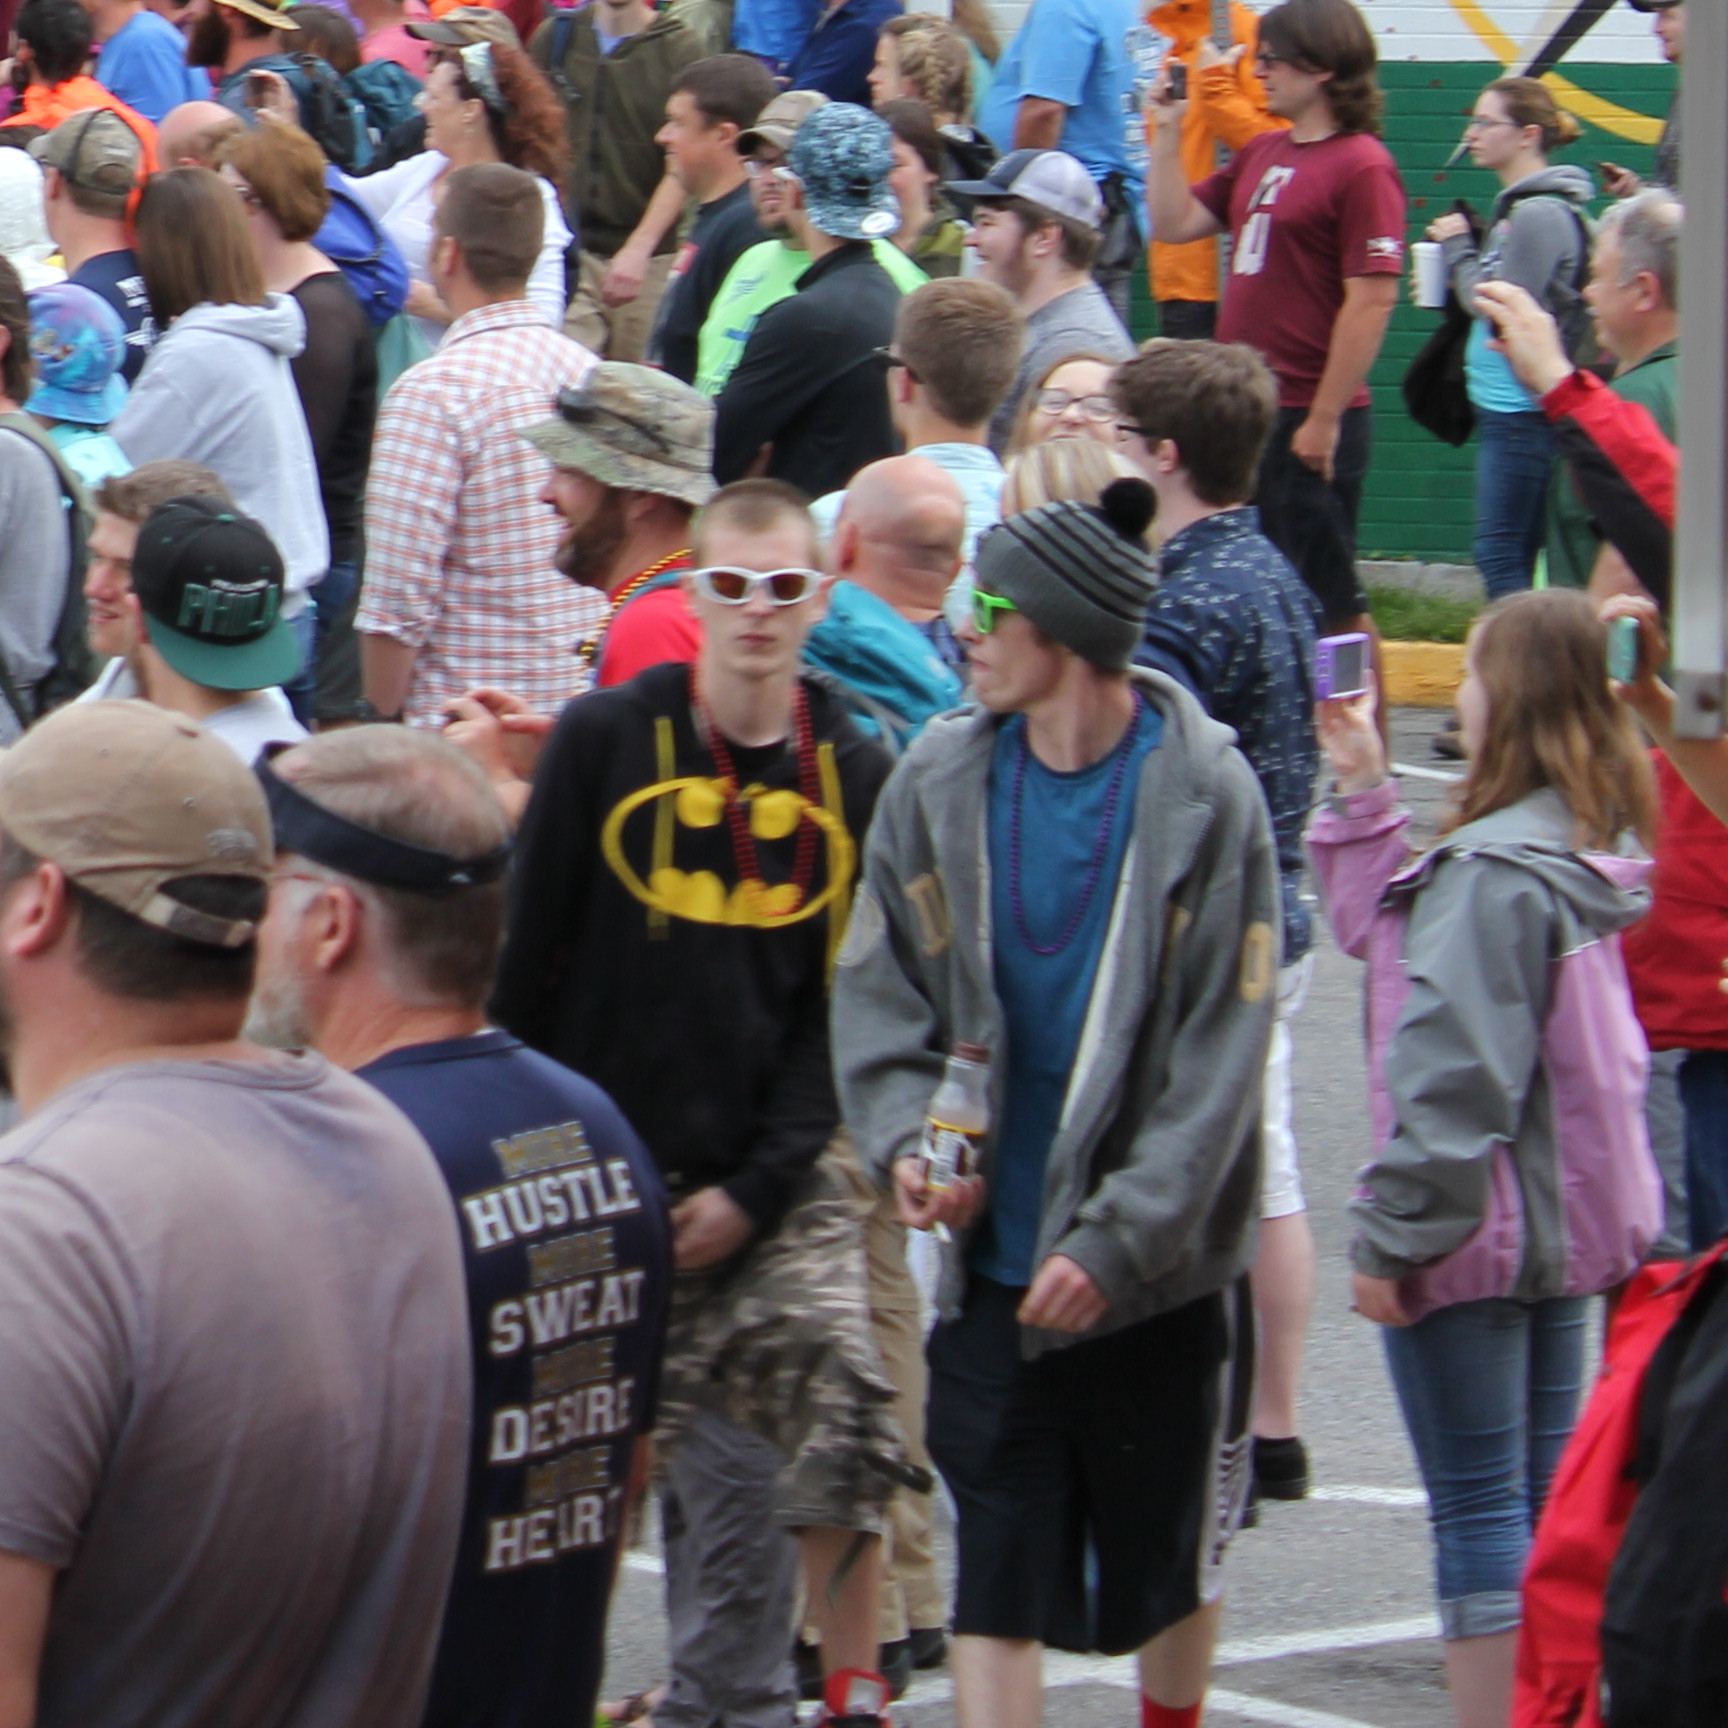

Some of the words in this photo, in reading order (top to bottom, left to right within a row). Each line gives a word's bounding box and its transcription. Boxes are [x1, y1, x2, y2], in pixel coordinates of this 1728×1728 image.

[461, 1159, 641, 1250] HUSTLE
[489, 1272, 644, 1356] SWEAT
[489, 1377, 637, 1463] DESIRE
